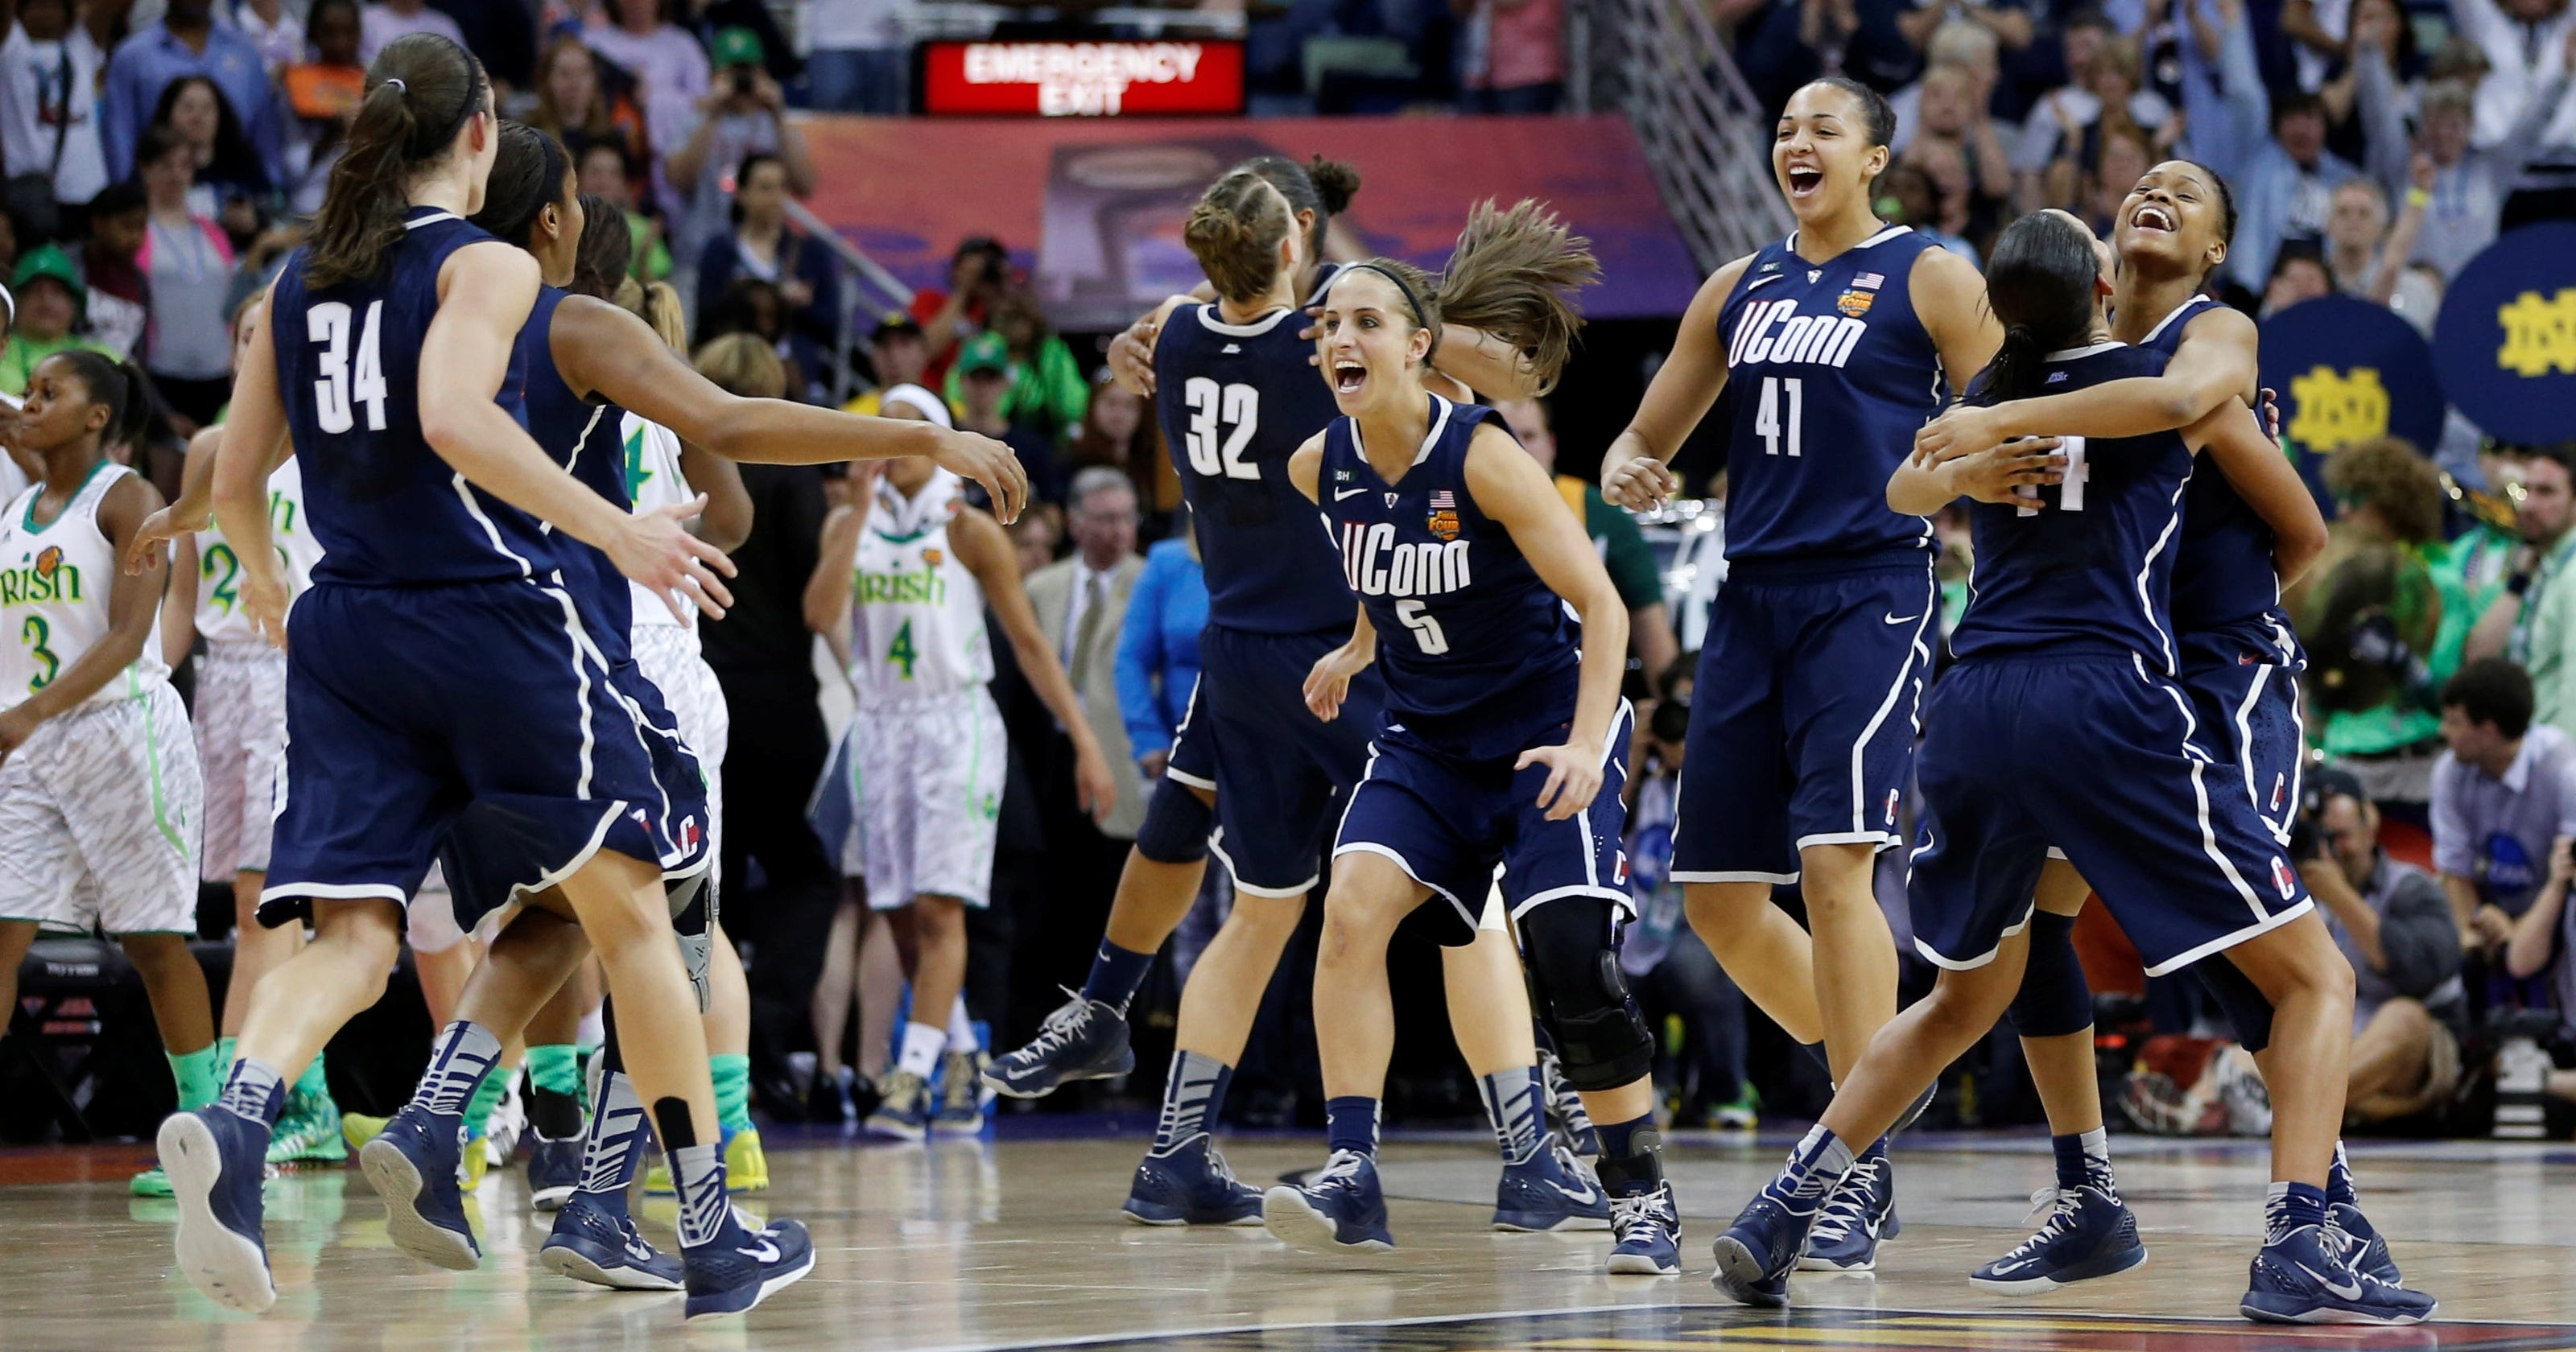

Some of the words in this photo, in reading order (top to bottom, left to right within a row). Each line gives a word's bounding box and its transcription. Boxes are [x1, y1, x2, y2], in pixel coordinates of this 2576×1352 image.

[964, 43, 1203, 83] EMERGENCY
[1038, 80, 1129, 116] EXIT
[307, 299, 388, 434] 34
[1185, 377, 1261, 480] 32
[1755, 377, 1802, 456] 41
[1336, 471, 1350, 481] SH
[21, 614, 60, 694] 3
[886, 615, 919, 682] 4
[1395, 600, 1449, 656] 5
